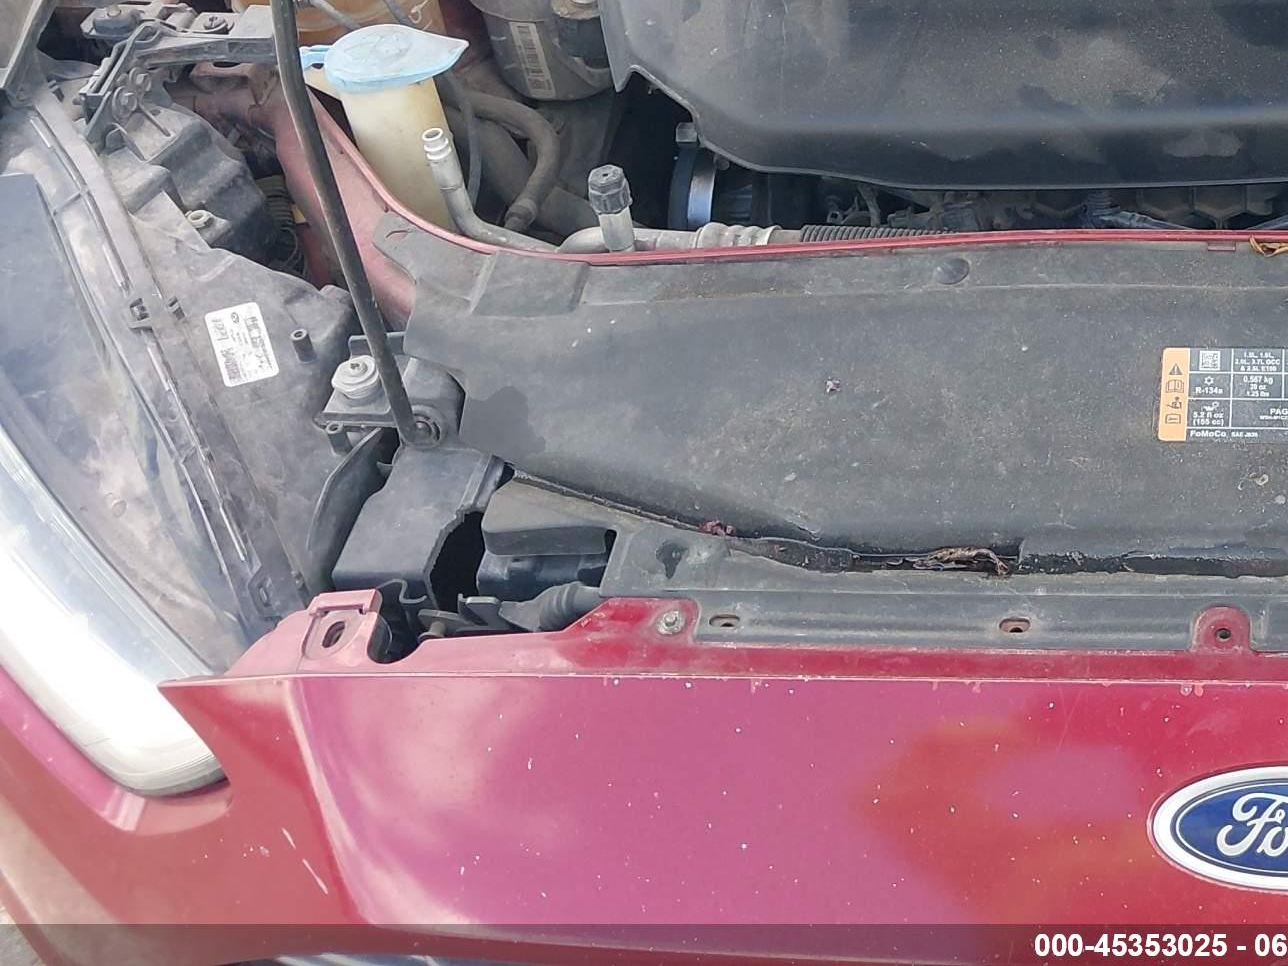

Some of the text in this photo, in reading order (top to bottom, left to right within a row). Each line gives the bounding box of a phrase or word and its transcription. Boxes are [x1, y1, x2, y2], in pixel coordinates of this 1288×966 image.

[1243, 375, 1274, 385] 0.567 kg
[1195, 386, 1224, 395] R-134a
[1192, 411, 1205, 419] 5.2
[1206, 411, 1213, 419] fl
[1192, 418, 1225, 427] (155 cc)
[1189, 429, 1227, 438] FoMoCo
